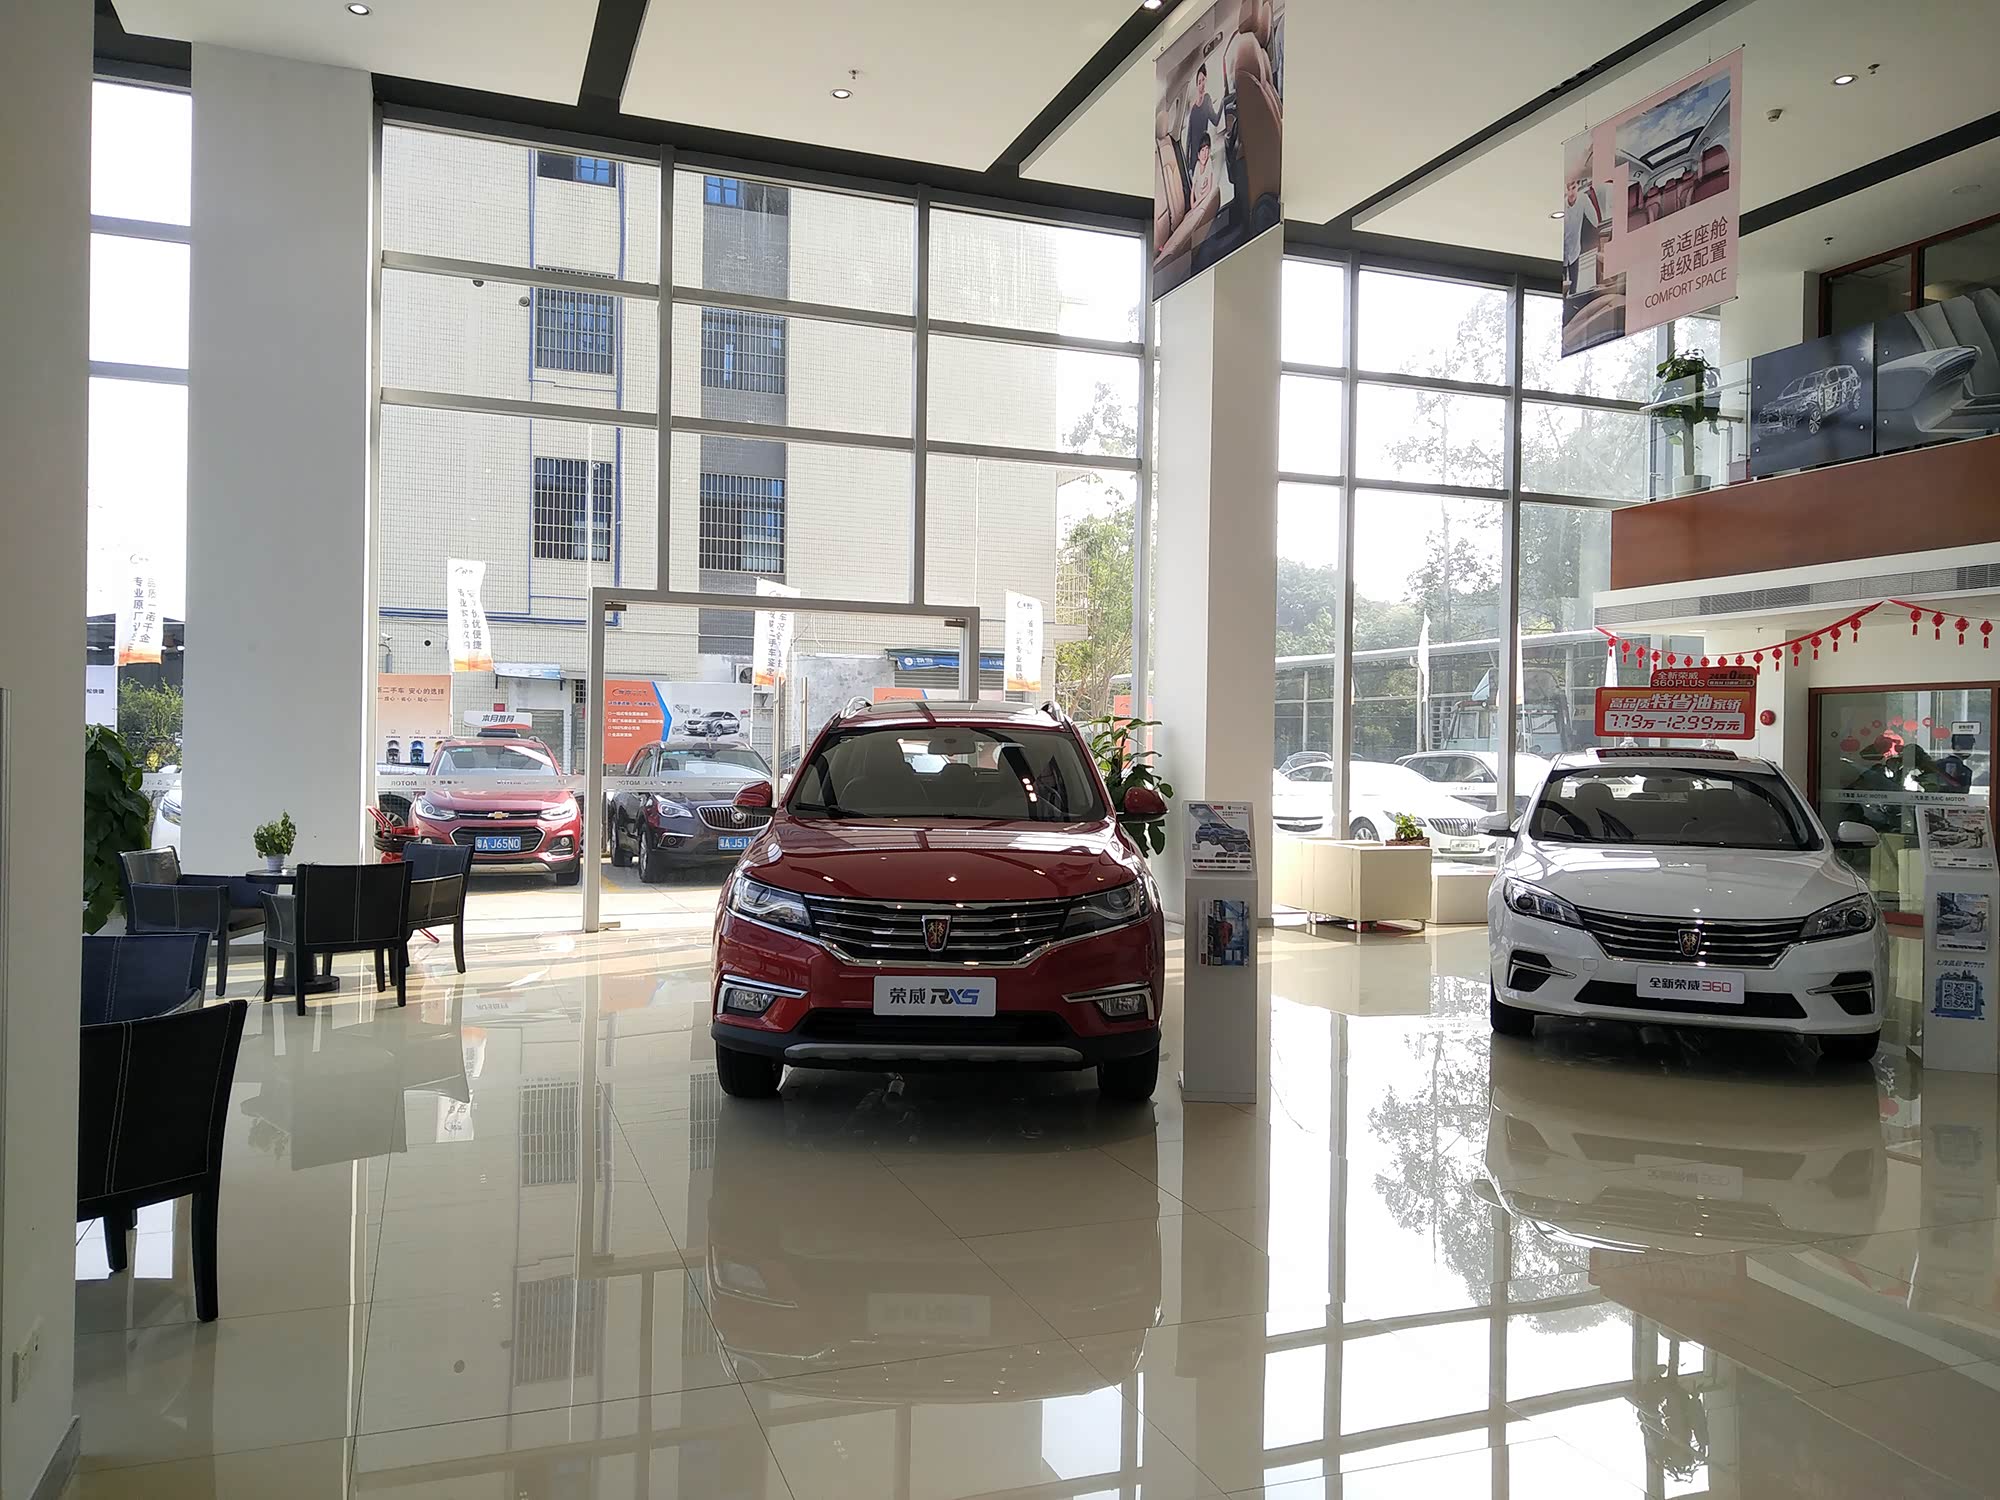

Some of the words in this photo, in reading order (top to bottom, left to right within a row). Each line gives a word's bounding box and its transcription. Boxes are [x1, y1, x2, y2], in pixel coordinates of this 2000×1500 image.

[1660, 216, 1728, 262] 宽适座舱
[1660, 239, 1727, 284] 越级配置
[1644, 279, 1695, 309] COMFORT
[1695, 267, 1727, 291] SPACE
[1652, 679, 1706, 688] 360PLUS
[1657, 671, 1699, 681] 全新荣威
[1609, 694, 1742, 713] 高品质特省油家轿
[889, 987, 926, 1005] 荣威
